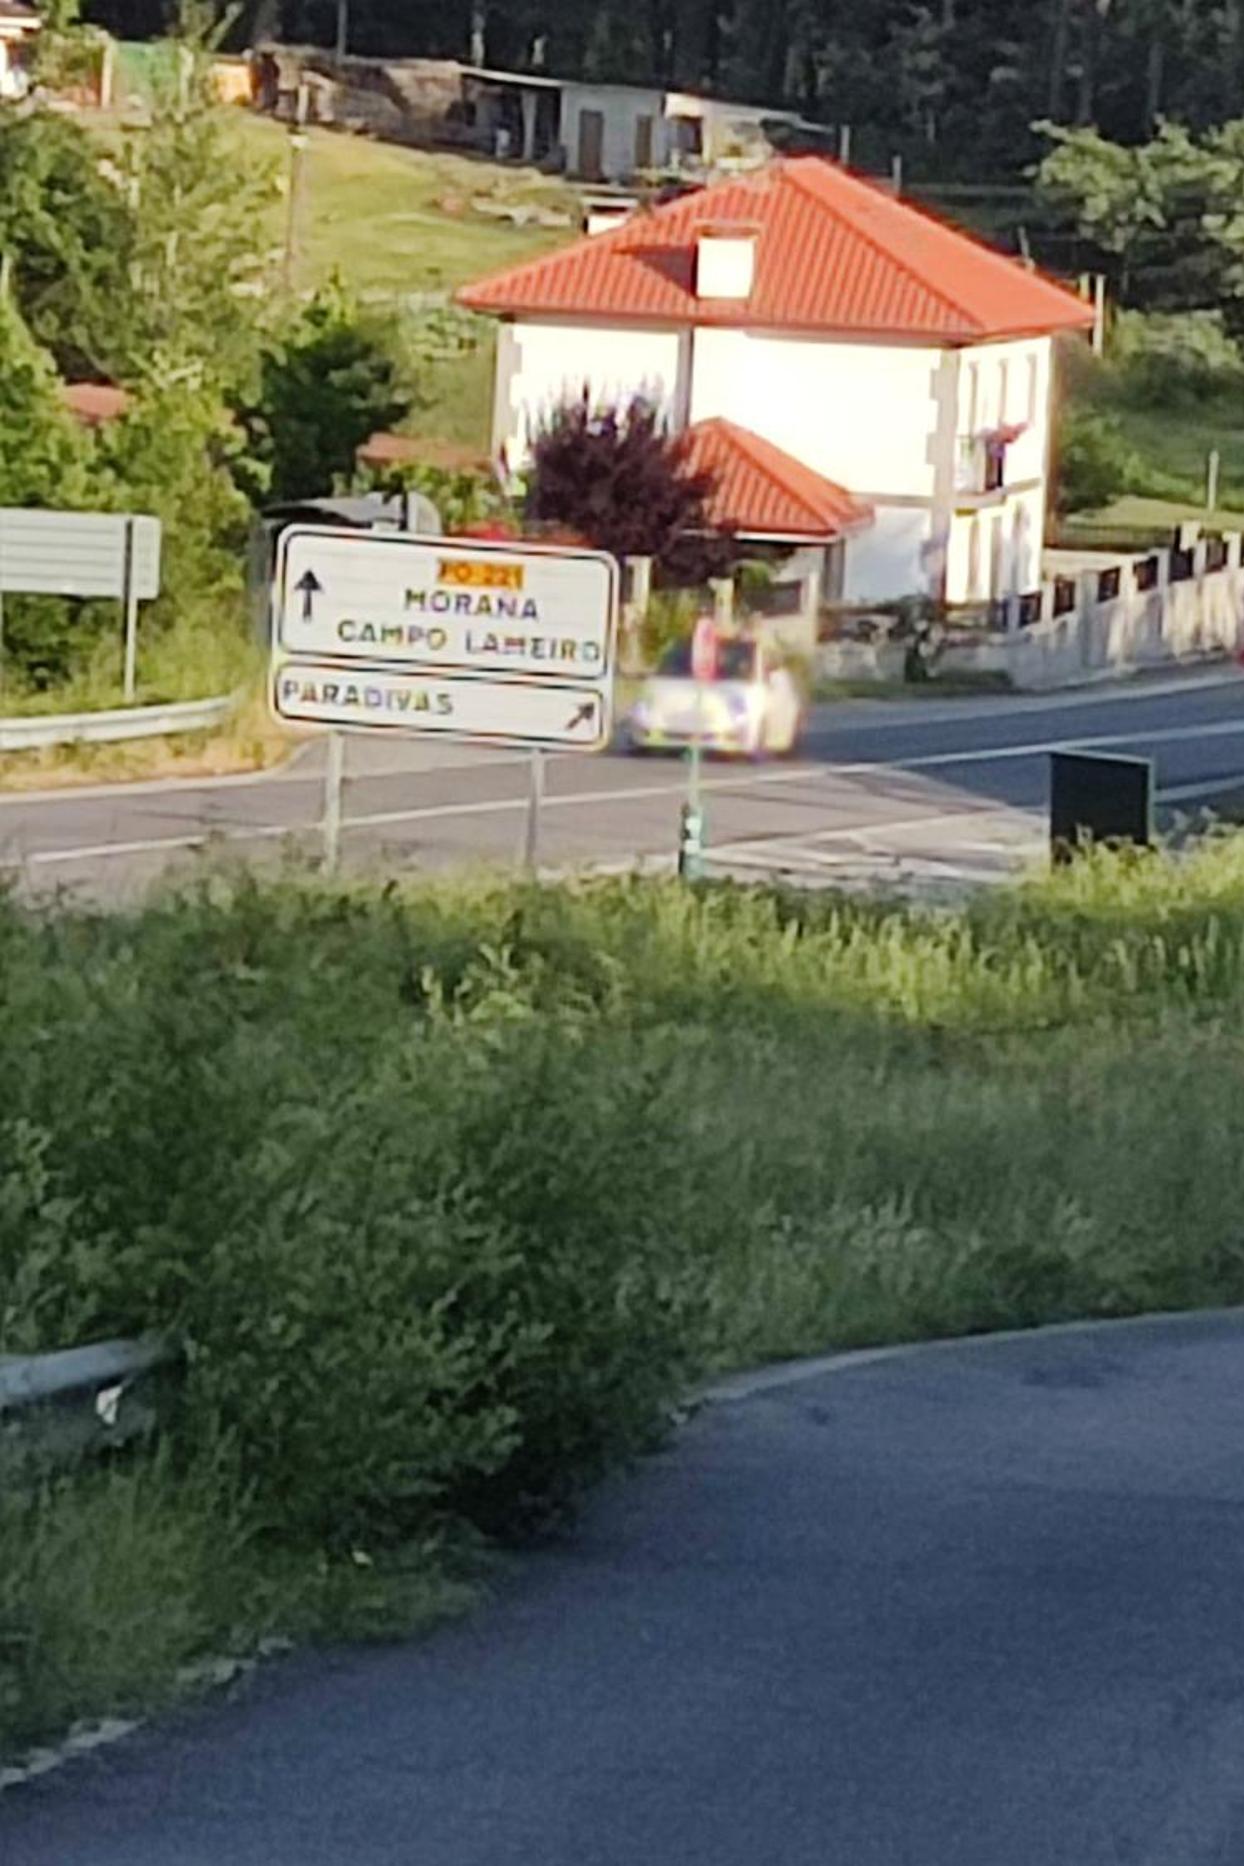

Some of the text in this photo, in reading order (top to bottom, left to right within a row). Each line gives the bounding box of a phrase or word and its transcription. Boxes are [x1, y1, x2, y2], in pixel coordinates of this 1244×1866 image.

[338, 619, 600, 660] CAMPO LAMEIRO
[283, 680, 453, 715] PARADIVAS
